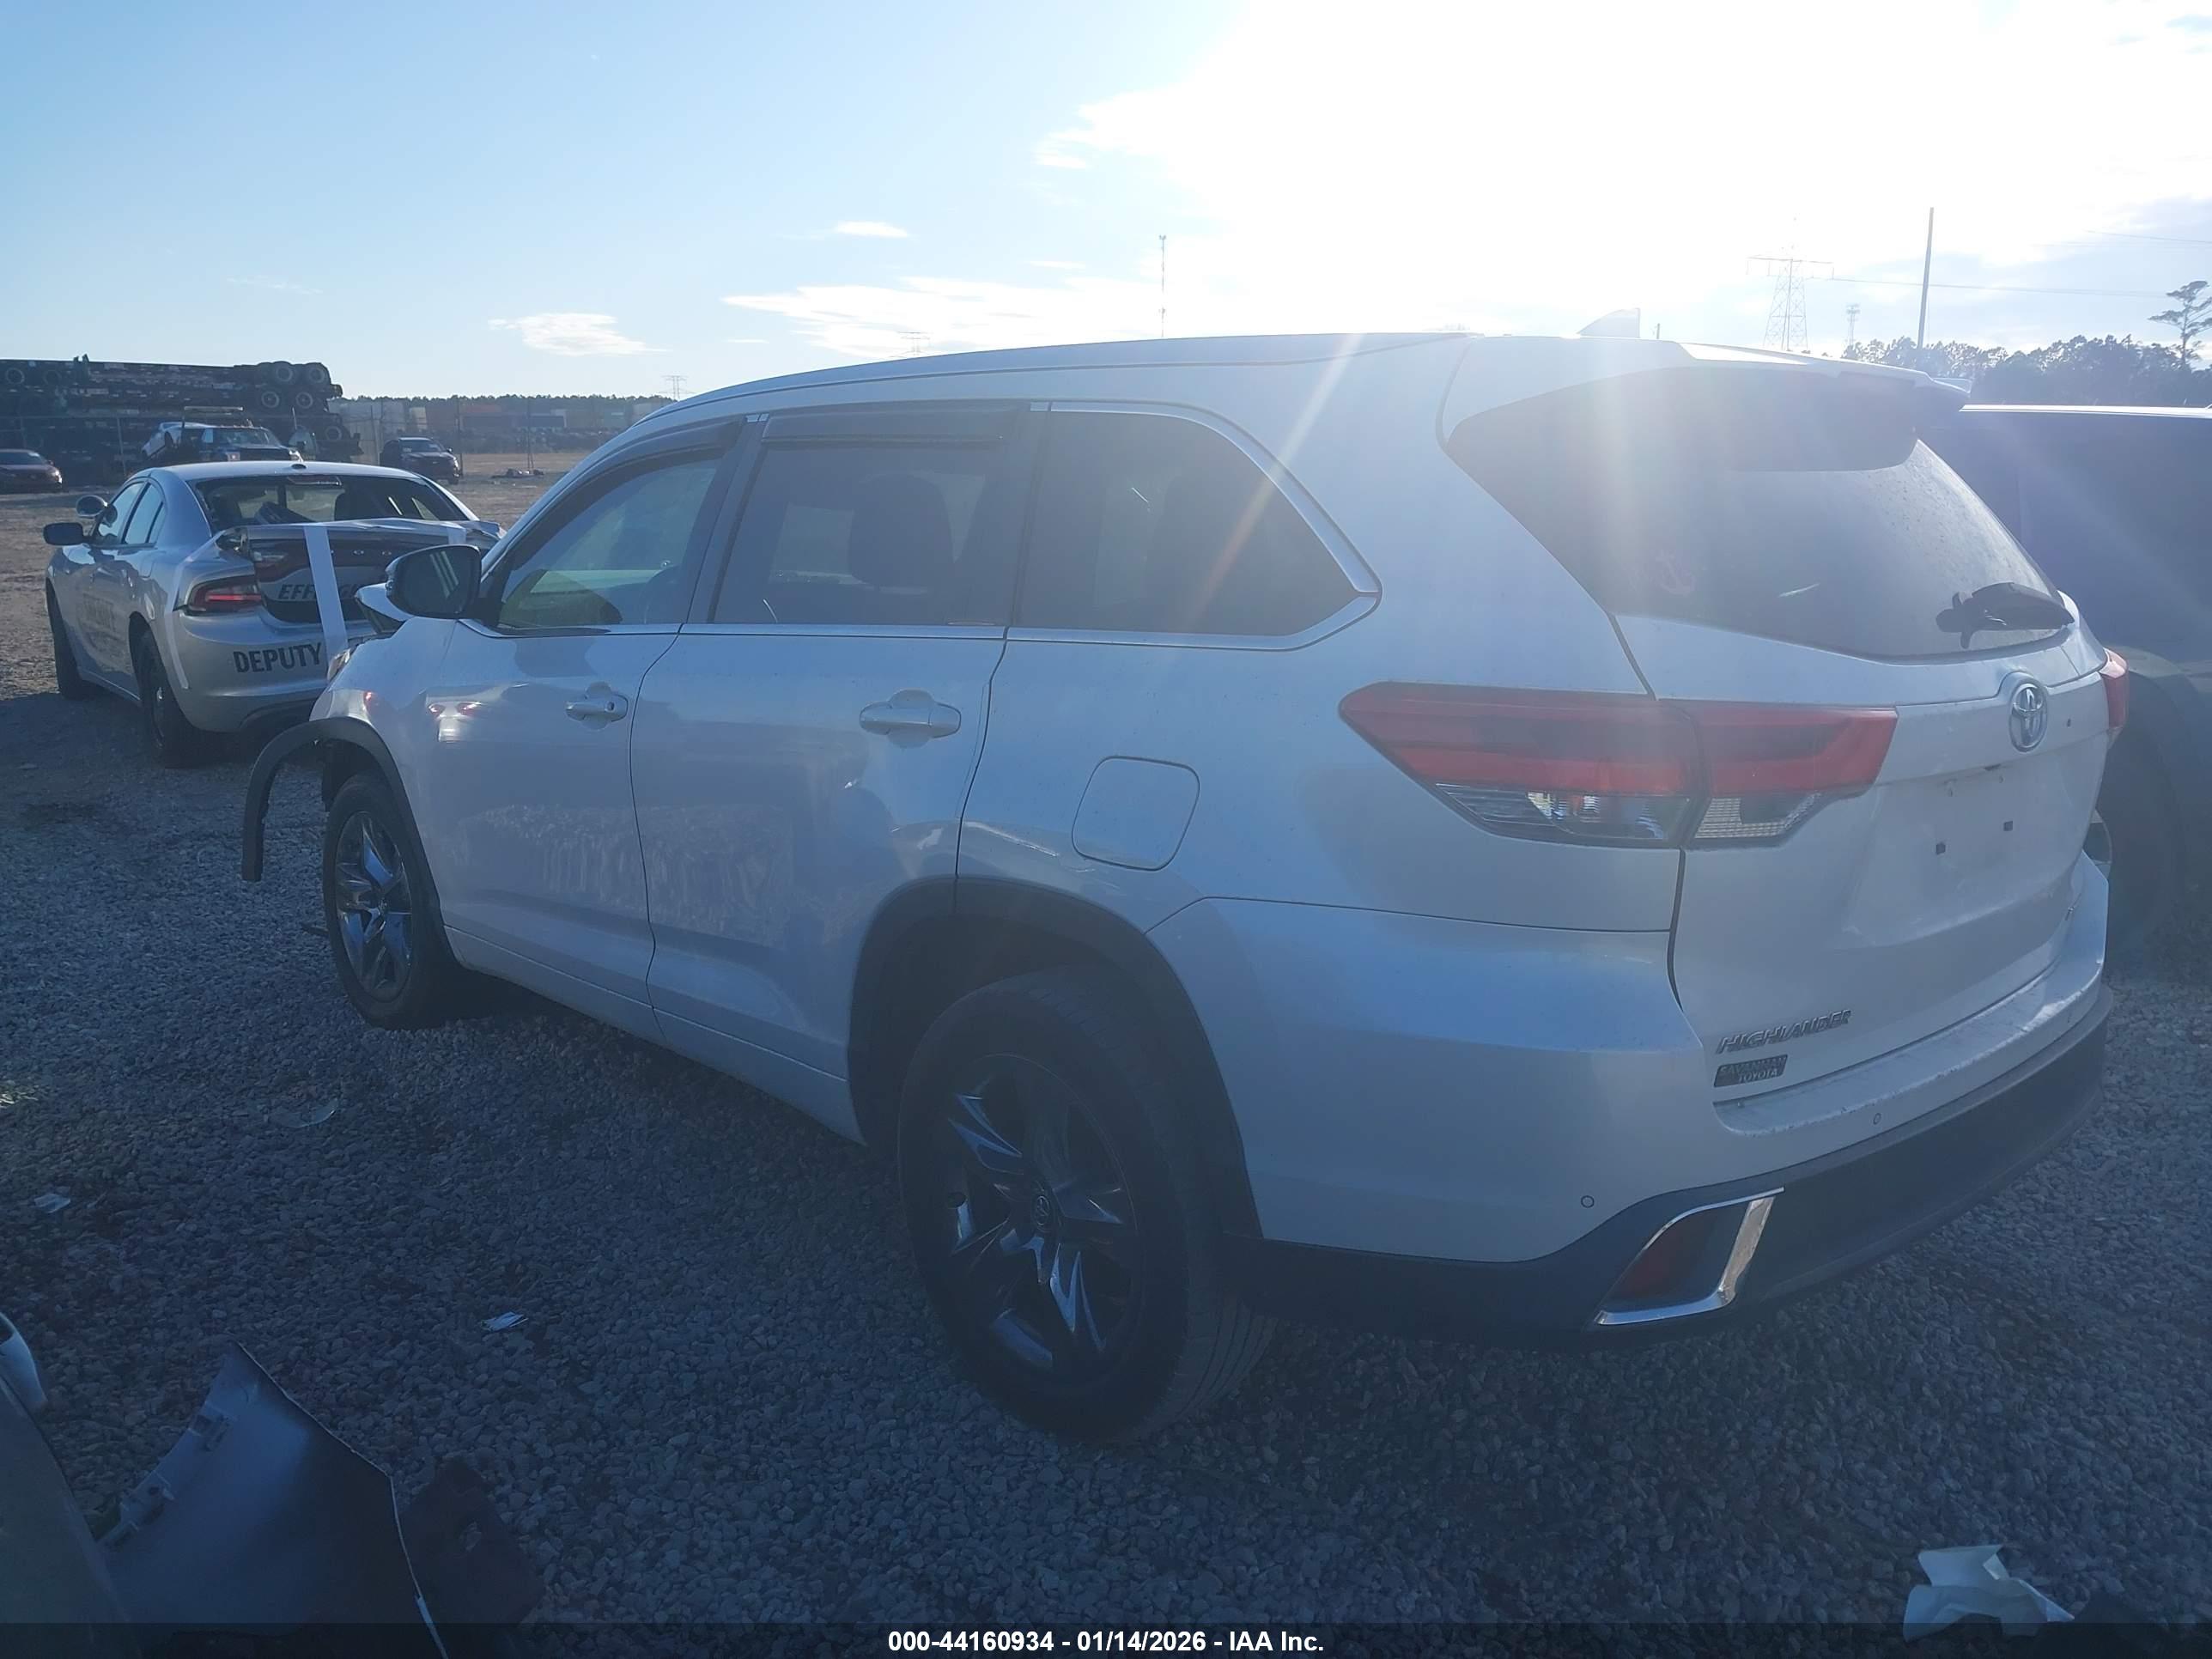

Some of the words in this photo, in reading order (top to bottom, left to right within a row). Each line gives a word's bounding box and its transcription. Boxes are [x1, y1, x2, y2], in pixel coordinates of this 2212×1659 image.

[233, 641, 322, 673] DEPUTY
[1716, 1008, 1852, 1054] HIGHLANDER
[1737, 1068, 1778, 1084] TOYOTA
